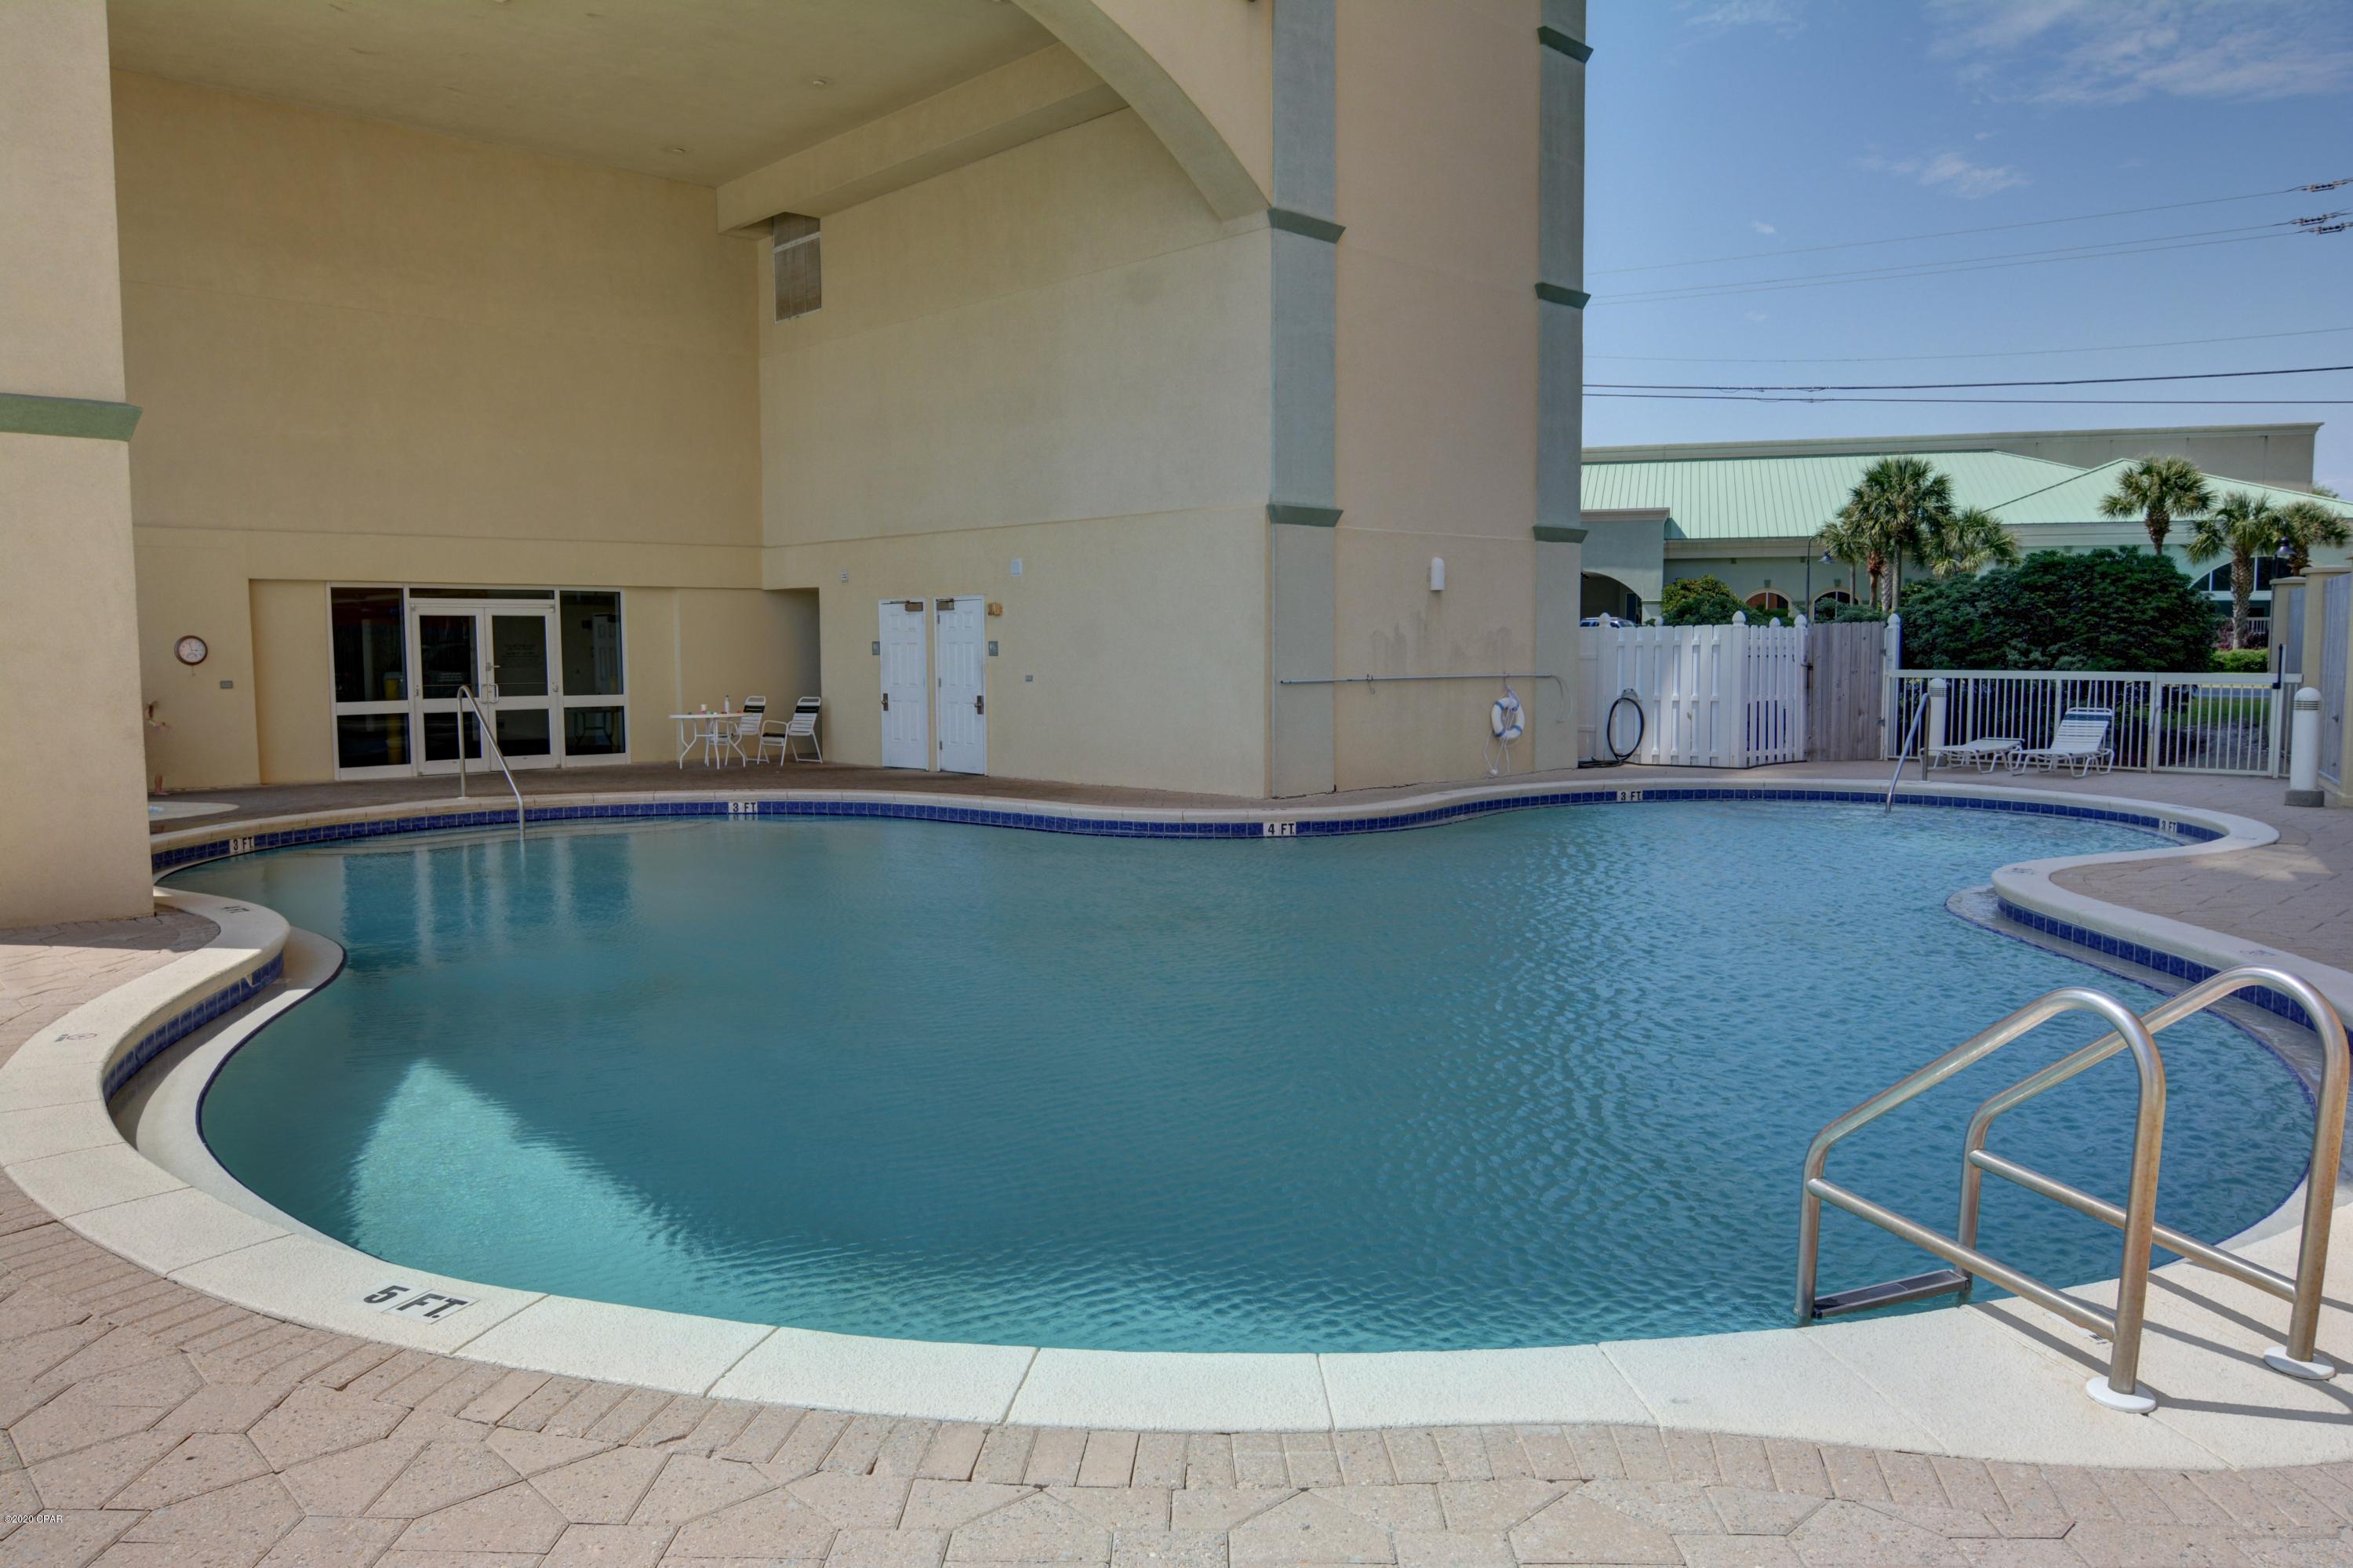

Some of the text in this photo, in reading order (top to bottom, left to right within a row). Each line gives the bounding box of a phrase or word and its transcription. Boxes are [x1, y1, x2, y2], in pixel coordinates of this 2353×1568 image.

[1620, 791, 1626, 801] 3
[733, 802, 739, 813] 3
[1267, 823, 1295, 835] 4 FT.
[2162, 820, 2166, 831] 3
[233, 839, 238, 851] 3
[363, 1285, 468, 1319] 5 FT.
